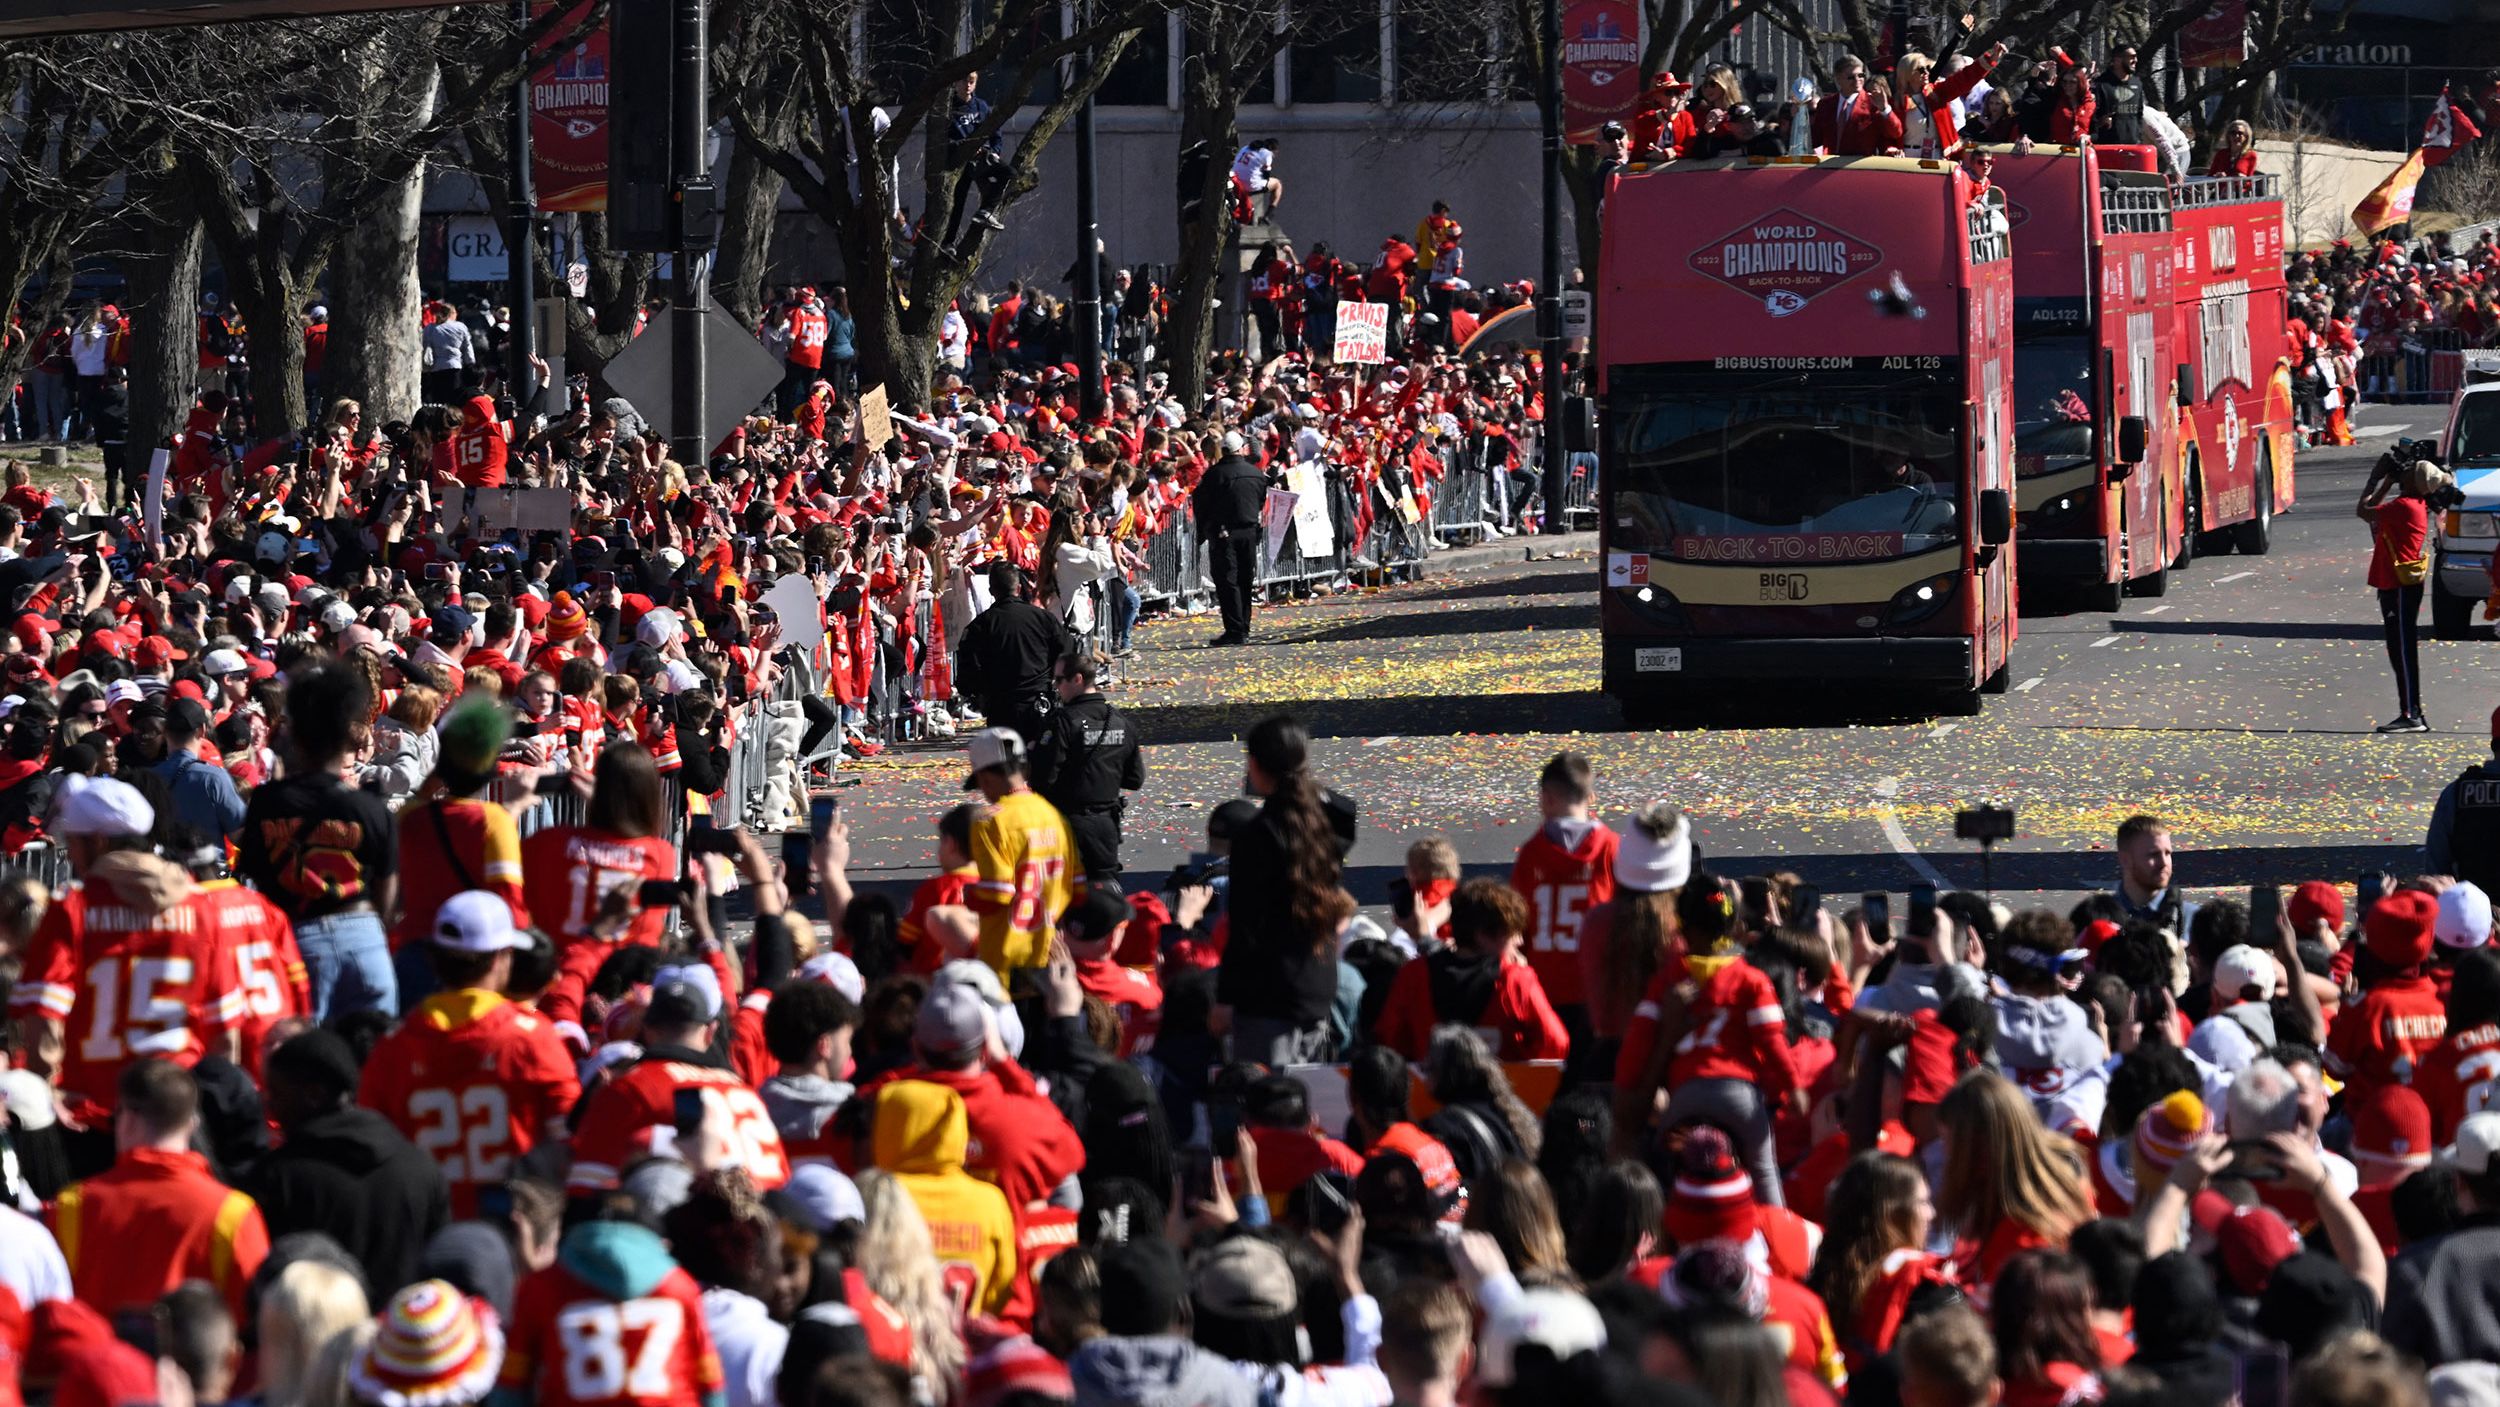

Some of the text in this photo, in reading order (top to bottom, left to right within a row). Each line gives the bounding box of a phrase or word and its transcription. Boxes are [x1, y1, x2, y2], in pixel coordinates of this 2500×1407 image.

[1565, 42, 1637, 63] CHAMPIONS
[1754, 226, 1817, 240] WORLD
[1697, 256, 1720, 265] 2022
[1723, 241, 1848, 278] CHAMPIONS
[801, 320, 826, 348] 58
[1714, 356, 1854, 369] BIGBUSTOURS.COM
[459, 436, 483, 467] 15
[1683, 535, 1893, 560] BACK TO BACK
[1632, 564, 1648, 575] 27
[1760, 573, 1787, 587] BIG
[1760, 588, 1787, 600] BUS
[1083, 729, 1125, 745] SHERIFF
[2464, 782, 2500, 805] POLI
[1531, 884, 1589, 952] 15
[236, 940, 283, 1016] 5
[81, 955, 194, 1062] 15
[408, 1085, 509, 1181] 22
[557, 1297, 685, 1401] 87
